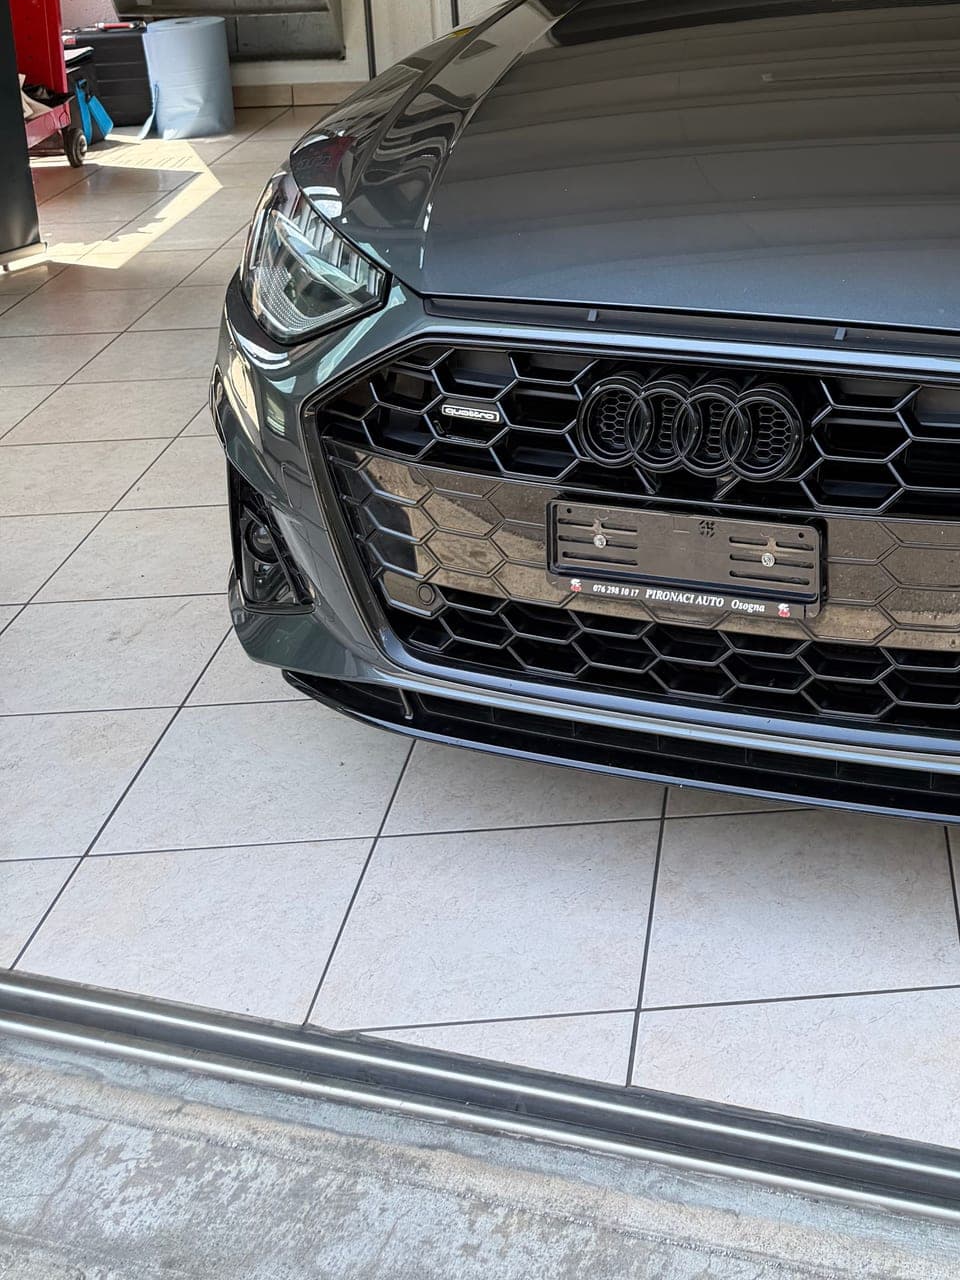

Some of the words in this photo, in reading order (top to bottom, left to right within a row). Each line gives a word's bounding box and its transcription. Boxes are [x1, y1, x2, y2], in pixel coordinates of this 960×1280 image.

[445, 407, 494, 420] quattro
[592, 584, 606, 593] 076
[620, 587, 629, 596] 10
[630, 588, 639, 597] 17
[645, 588, 694, 604] PIRONACI
[695, 595, 724, 607] AUTO
[731, 599, 765, 613] Osogna
